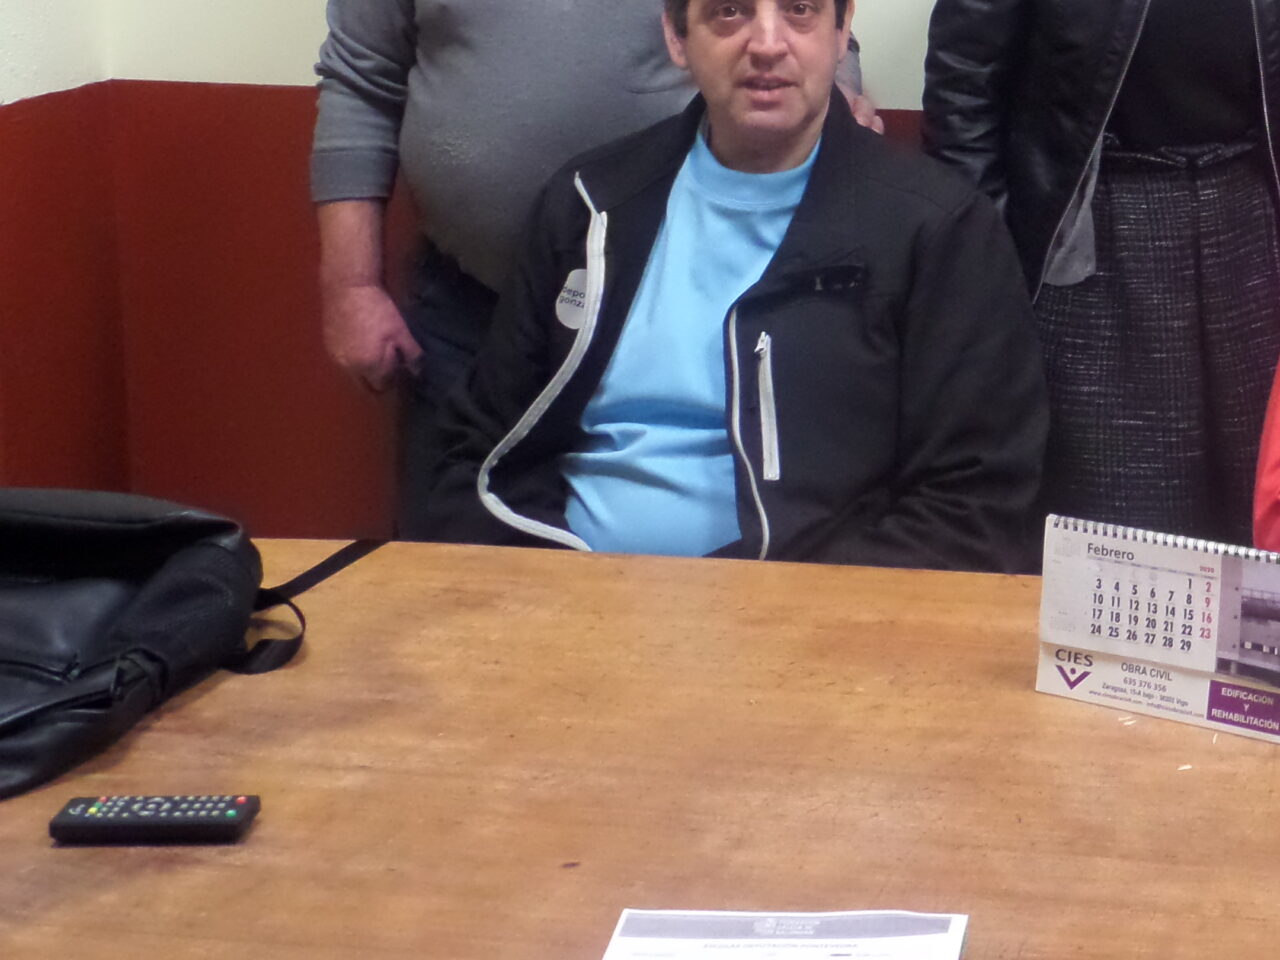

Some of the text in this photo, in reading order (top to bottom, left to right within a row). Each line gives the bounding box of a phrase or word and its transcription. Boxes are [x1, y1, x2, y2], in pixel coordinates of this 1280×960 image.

[1087, 542, 1135, 561] Febrero
[1095, 578, 1211, 608] 3 4 5 6 7 8 9
[1205, 581, 1212, 593] 2
[1093, 593, 1212, 624] 10 11 12 13 14 15 16
[1091, 608, 1211, 639] 17 18 19 20 21 22 23
[1090, 623, 1192, 652] 24 25 26 27 28 29
[1055, 648, 1093, 667] CIES
[1121, 662, 1173, 681] OBRA CIVIL
[1123, 677, 1137, 687] 635
[1153, 683, 1167, 692] 356
[1176, 697, 1189, 707] Vigo
[1221, 687, 1274, 706] EDIFICACIÓN
[1243, 704, 1250, 713] Y
[1211, 708, 1279, 731] REHABILITACIÓN
